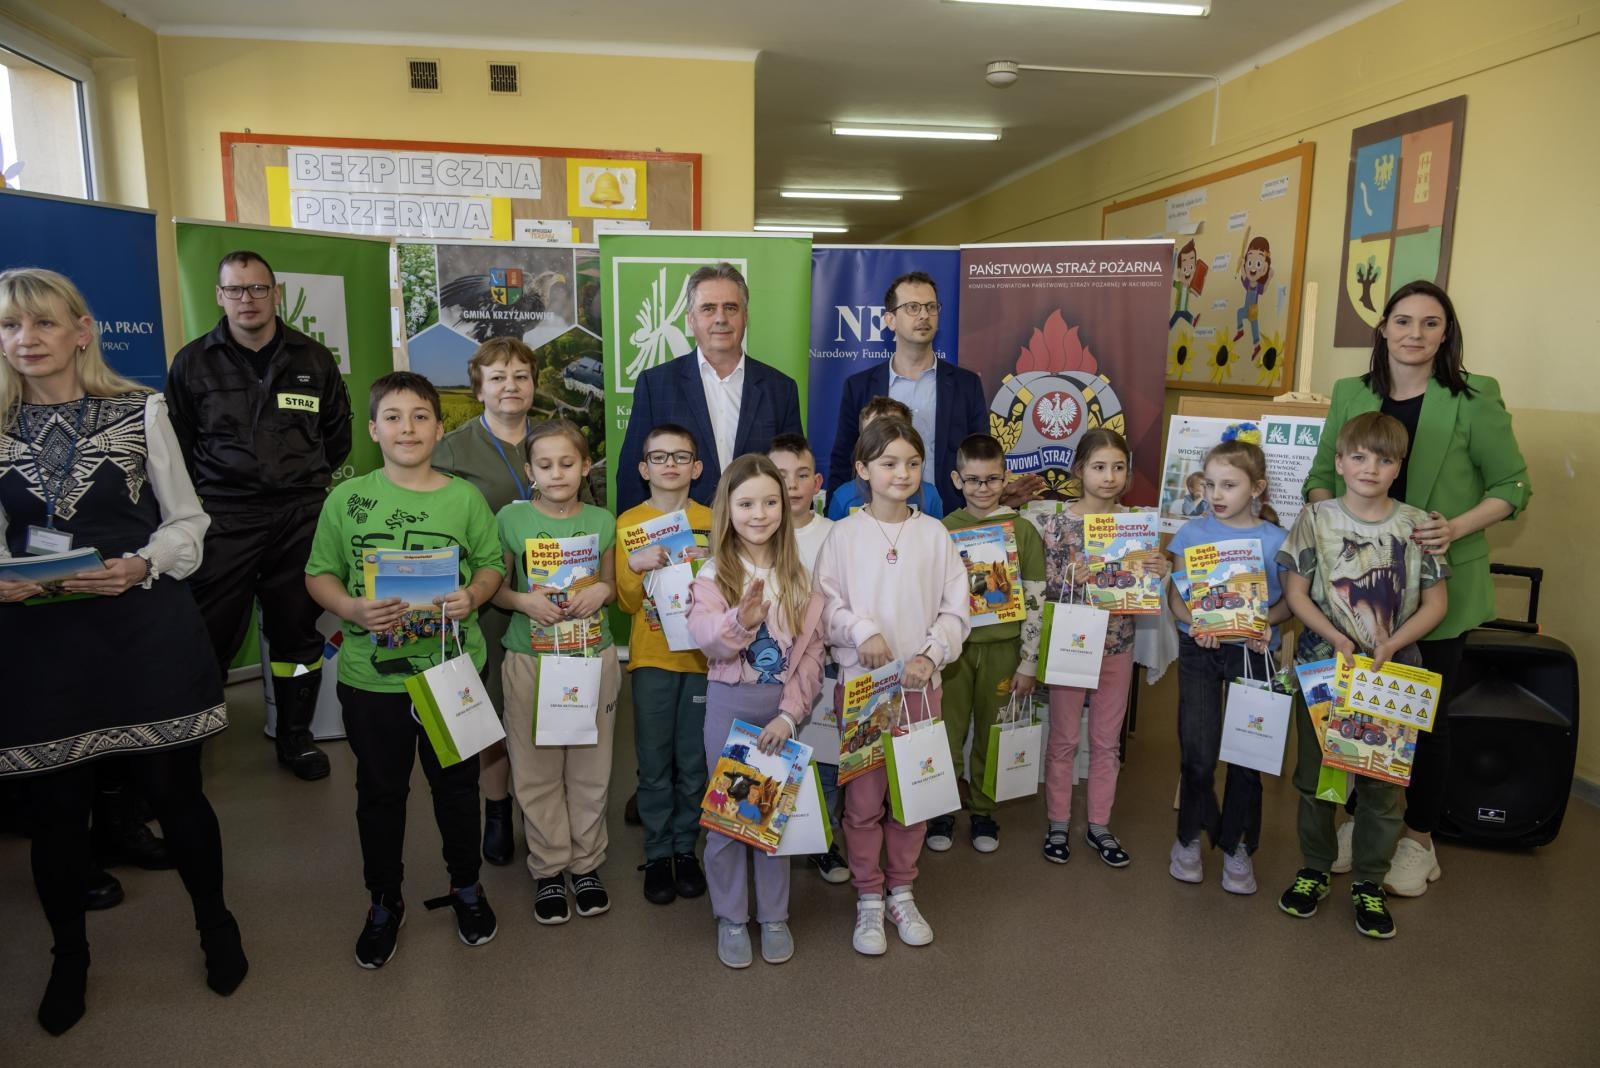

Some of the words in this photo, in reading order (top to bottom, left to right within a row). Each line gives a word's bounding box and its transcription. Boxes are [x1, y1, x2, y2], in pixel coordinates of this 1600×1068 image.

[295, 153, 540, 190] BEZPIECZNA
[296, 196, 490, 230] PRZERWA
[969, 262, 1052, 275] PAŃSTWOWA
[1056, 260, 1096, 274] STRAŻ
[1100, 259, 1162, 273] POŻARNA
[463, 310, 491, 320] GMINA
[115, 321, 154, 334] PRACY
[102, 342, 130, 351] PRACY
[808, 348, 859, 363] Narodowy
[1043, 450, 1071, 464] STRAŻ
[347, 493, 378, 511] BOOM!
[1095, 517, 1114, 525] Bądź
[1089, 523, 1149, 533] bezpieczny
[624, 524, 680, 546] bezpieczny
[1098, 531, 1156, 540] gospodarstwie
[538, 542, 559, 551] Bądź
[532, 548, 593, 559] bezpieczny
[1190, 549, 1252, 562] bezpieczny
[849, 671, 899, 699] bezpieczny
